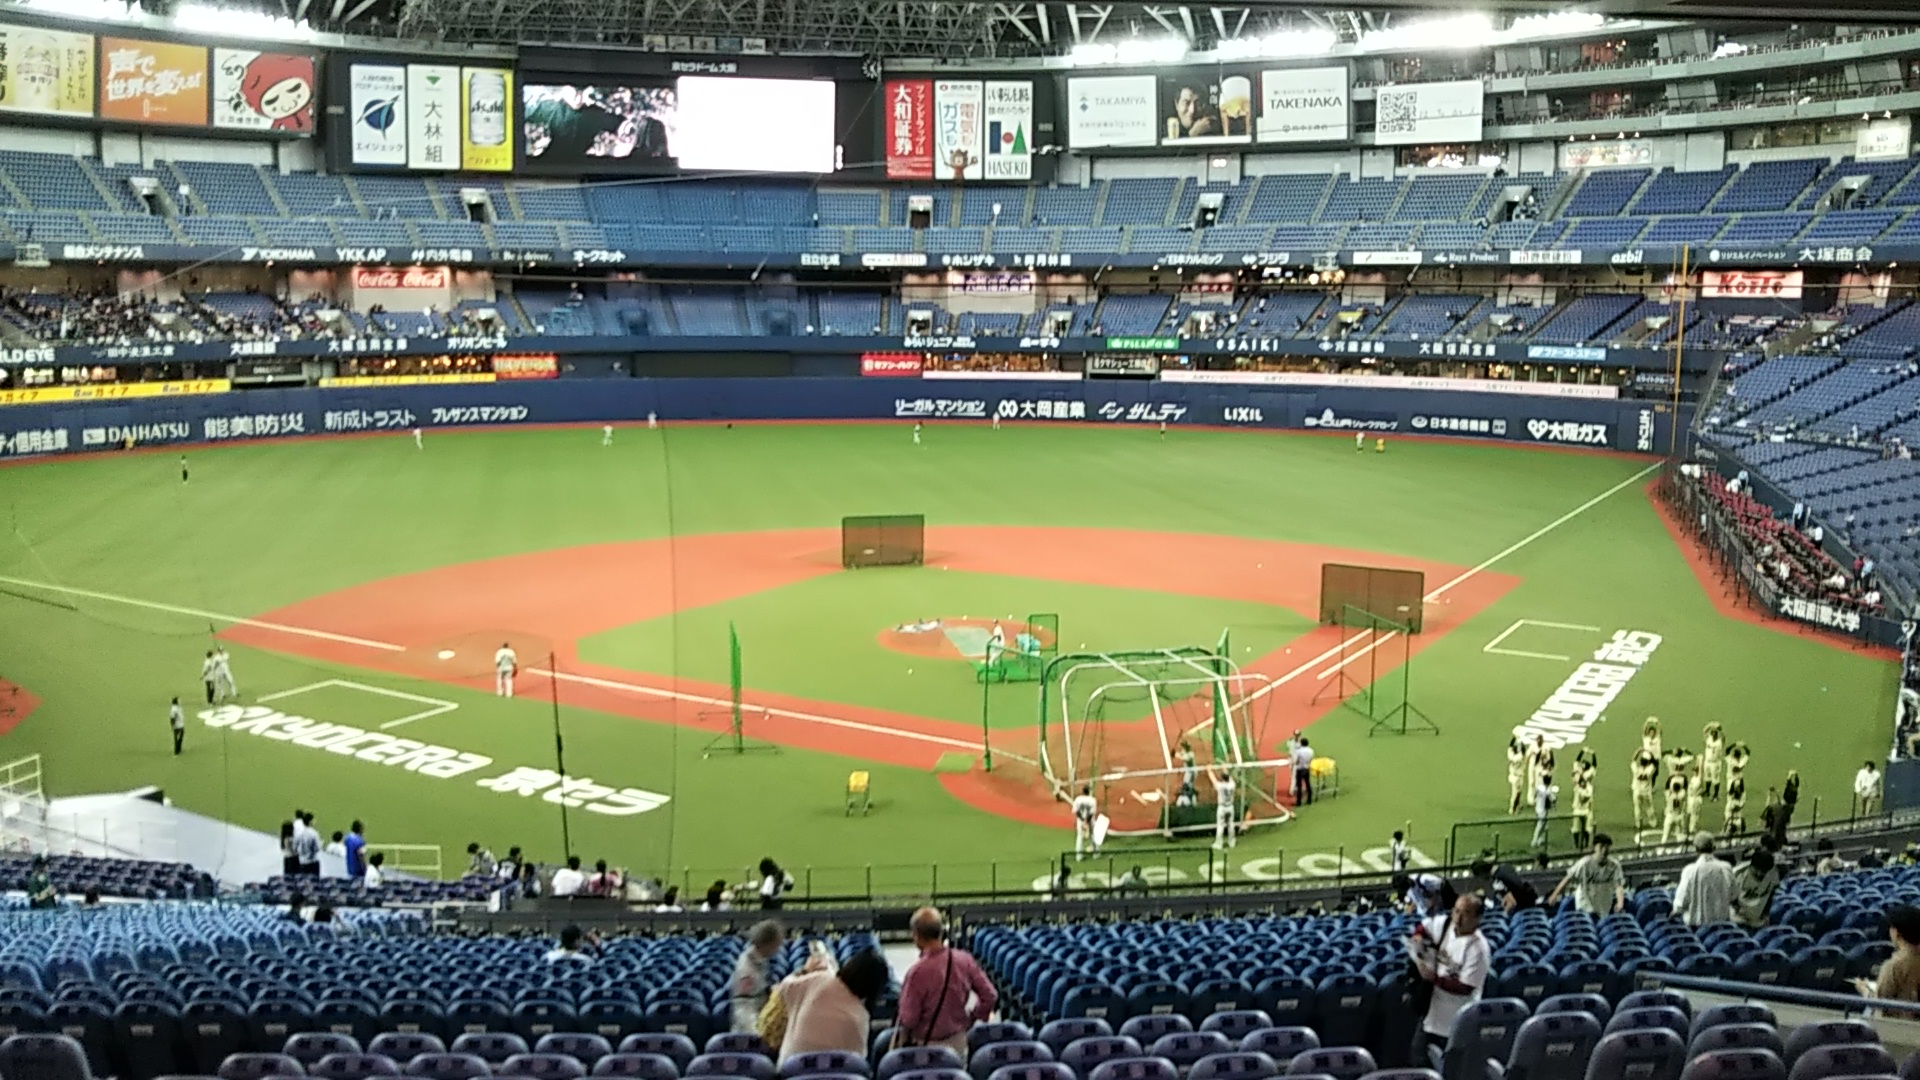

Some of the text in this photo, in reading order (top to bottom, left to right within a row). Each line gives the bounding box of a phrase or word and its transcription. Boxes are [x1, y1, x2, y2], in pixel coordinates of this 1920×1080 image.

[108, 48, 155, 79] 声で
[471, 99, 504, 113] Asahi
[1095, 96, 1147, 106] TAKAMIYA
[1271, 96, 1343, 110] TAKENAKA
[893, 84, 914, 156] 大和証券
[915, 85, 926, 155] ファンドラップは
[943, 102, 958, 146] ガスも
[424, 101, 443, 163] 大林組
[356, 143, 403, 153] エイジェック
[988, 161, 1028, 176] HASEKO
[259, 249, 316, 261] YOKOHAMA
[336, 248, 387, 262] YKK AP
[574, 250, 627, 262] オークネット
[952, 254, 996, 267] ホシザキ
[1168, 254, 1224, 266] 日本カルミック
[1258, 253, 1290, 266] フジタ
[1470, 253, 1500, 263] Product
[1611, 249, 1644, 263] azbil
[1798, 247, 1873, 262] 大塚商会
[1717, 273, 1784, 294] Koito
[447, 336, 508, 349] オリオンビール
[25, 347, 55, 362] EYE
[432, 405, 528, 423] プレサンスマンション
[1020, 399, 1086, 419] 大岡産業
[1126, 402, 1187, 421] サムティ
[1224, 406, 1263, 422] LIXIL
[204, 412, 304, 440] 能美防災
[325, 410, 416, 430] 新成トラスト
[108, 421, 191, 443] DAIHATSU
[1548, 422, 1608, 444] 大阪ガス
[1779, 595, 1861, 633] 大阪商業大学
[242, 714, 672, 816] KYOCERA 京セラ
